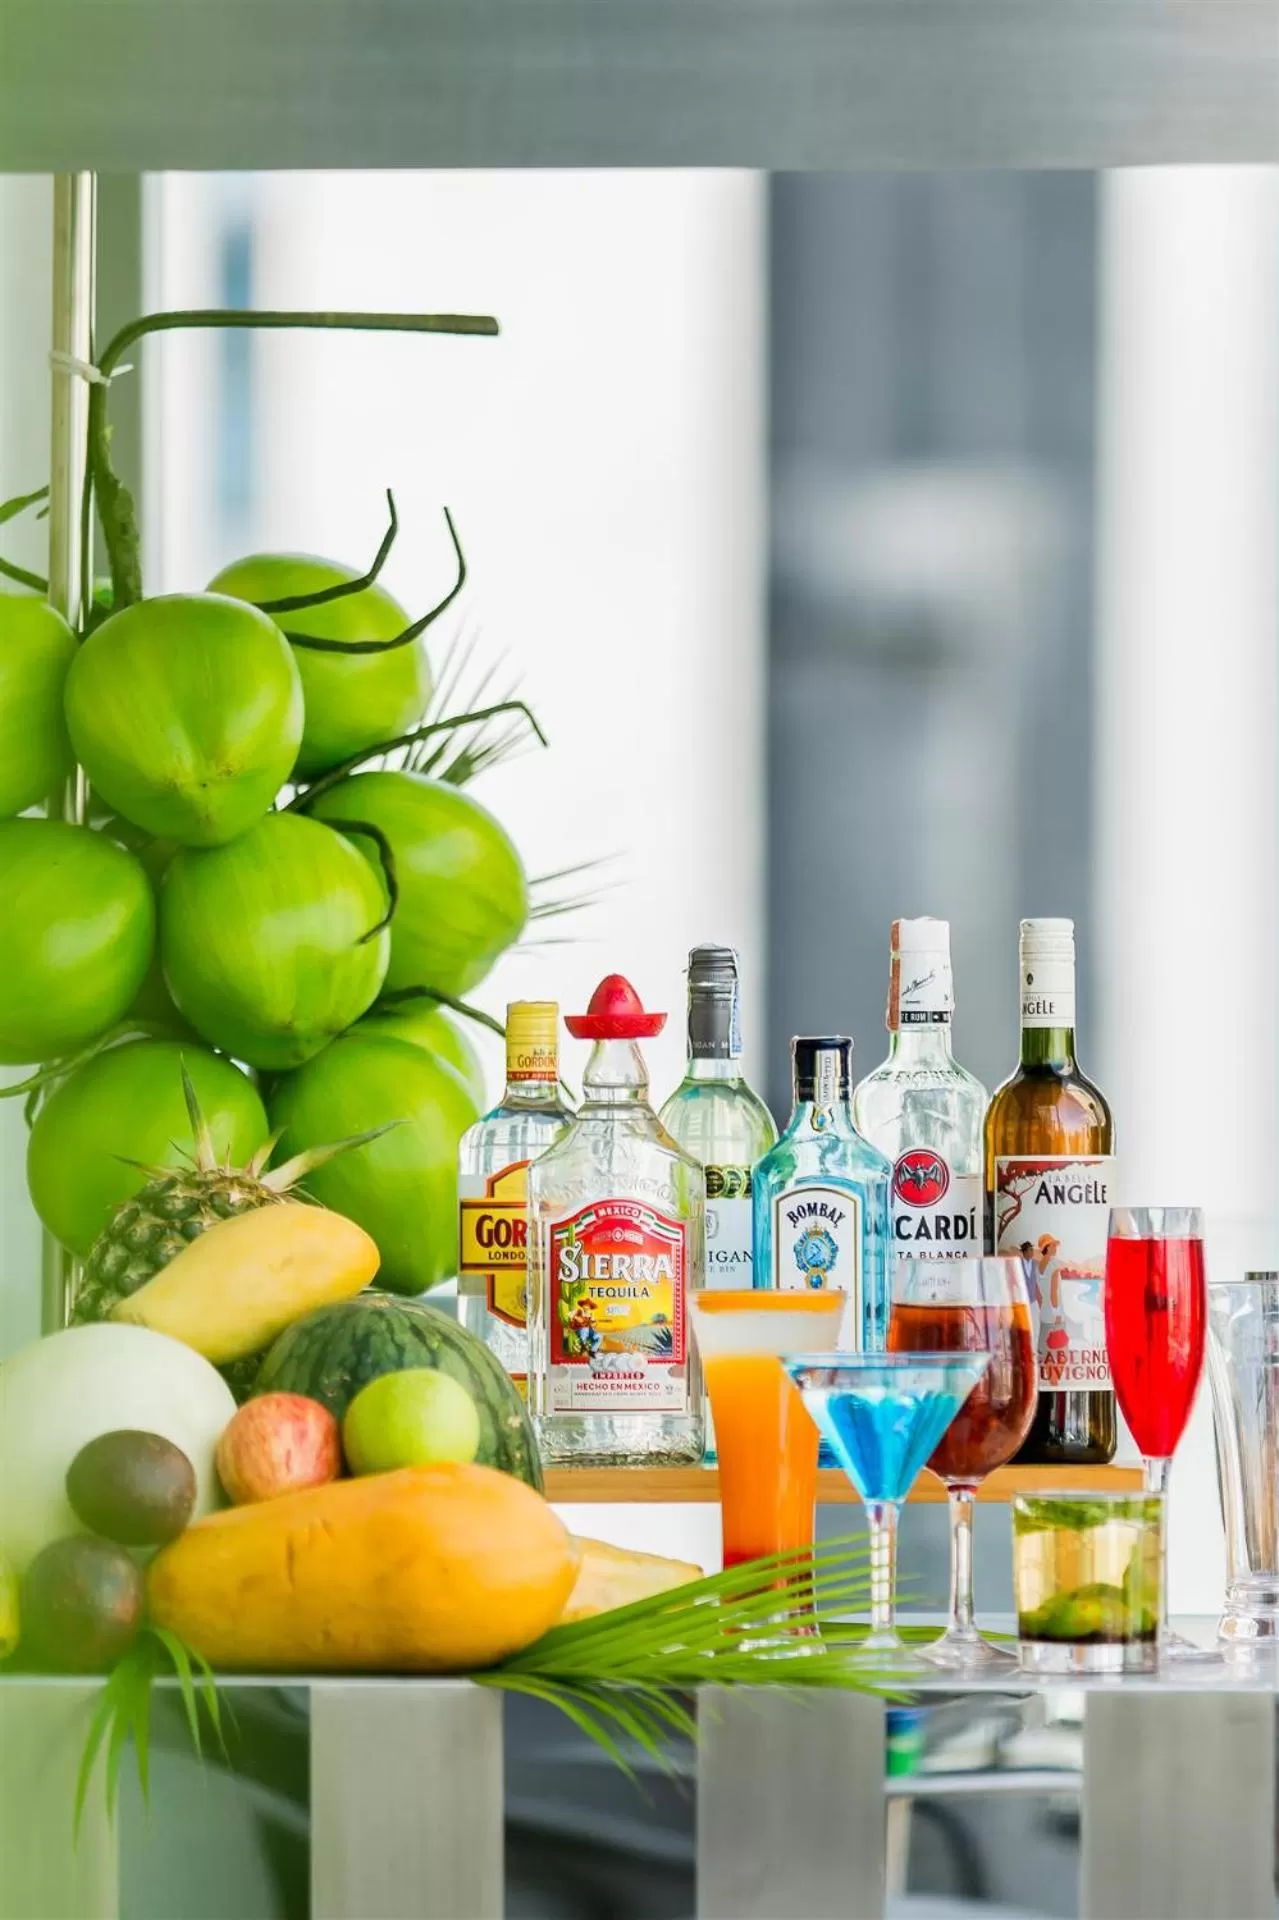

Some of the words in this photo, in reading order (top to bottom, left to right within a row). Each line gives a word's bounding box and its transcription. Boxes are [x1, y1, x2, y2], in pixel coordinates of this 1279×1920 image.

[598, 1206, 640, 1217] MEXICO
[786, 1202, 846, 1228] BOMBAY
[920, 1251, 968, 1259] BLANCA
[558, 1240, 676, 1283] SIERRA
[589, 1287, 650, 1298] TEQUILA
[576, 1383, 608, 1391] HECHO
[610, 1383, 622, 1391] EN
[624, 1383, 660, 1391] MEXICO
